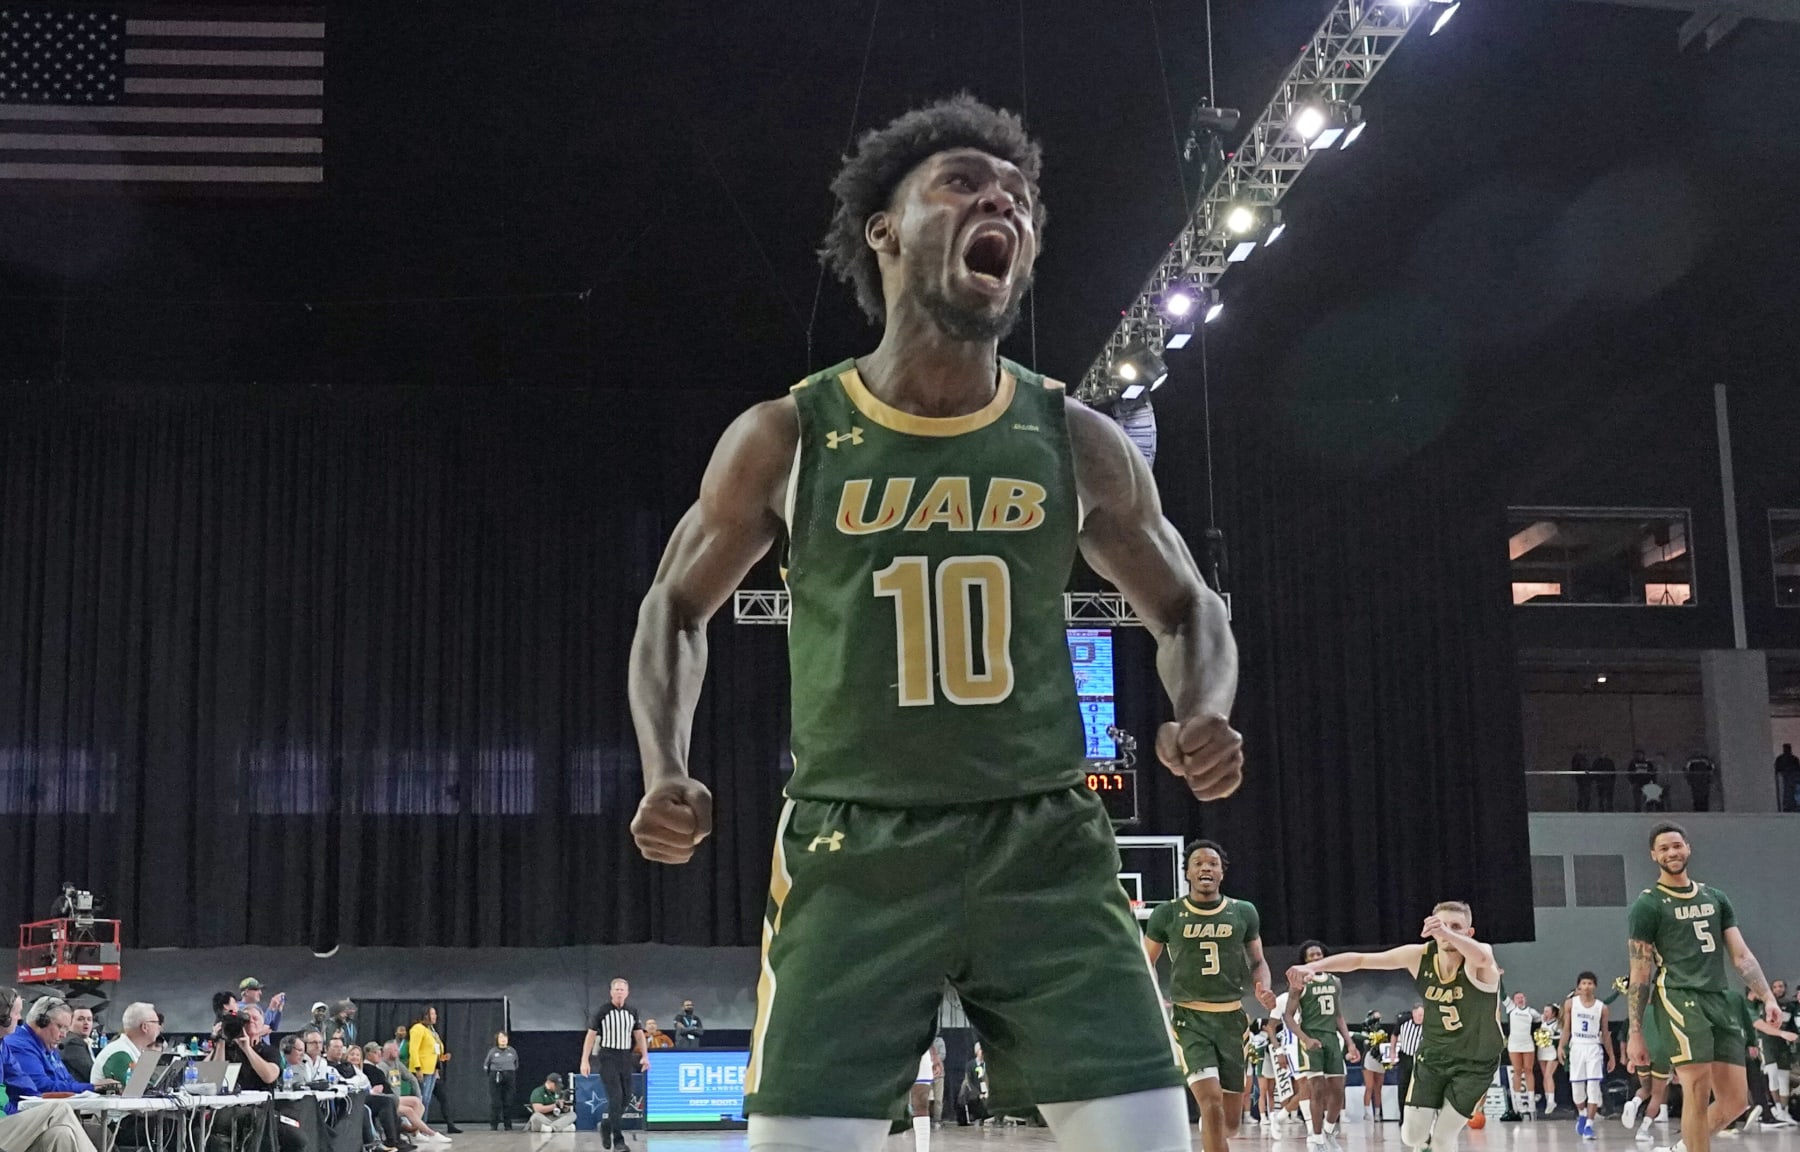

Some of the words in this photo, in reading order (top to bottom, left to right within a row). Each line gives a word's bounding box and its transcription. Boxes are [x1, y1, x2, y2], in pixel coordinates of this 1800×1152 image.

[836, 476, 1046, 535] UAB
[872, 555, 1014, 707] 10
[1674, 903, 1716, 920] UAB
[1182, 923, 1233, 939] UAB
[1692, 919, 1717, 953] 5
[1199, 941, 1221, 976] 3
[1311, 985, 1336, 995] UAB
[1424, 985, 1464, 1004] UAB
[1317, 994, 1335, 1016] 13
[1438, 1004, 1463, 1031] 2
[1581, 1020, 1589, 1032] 3
